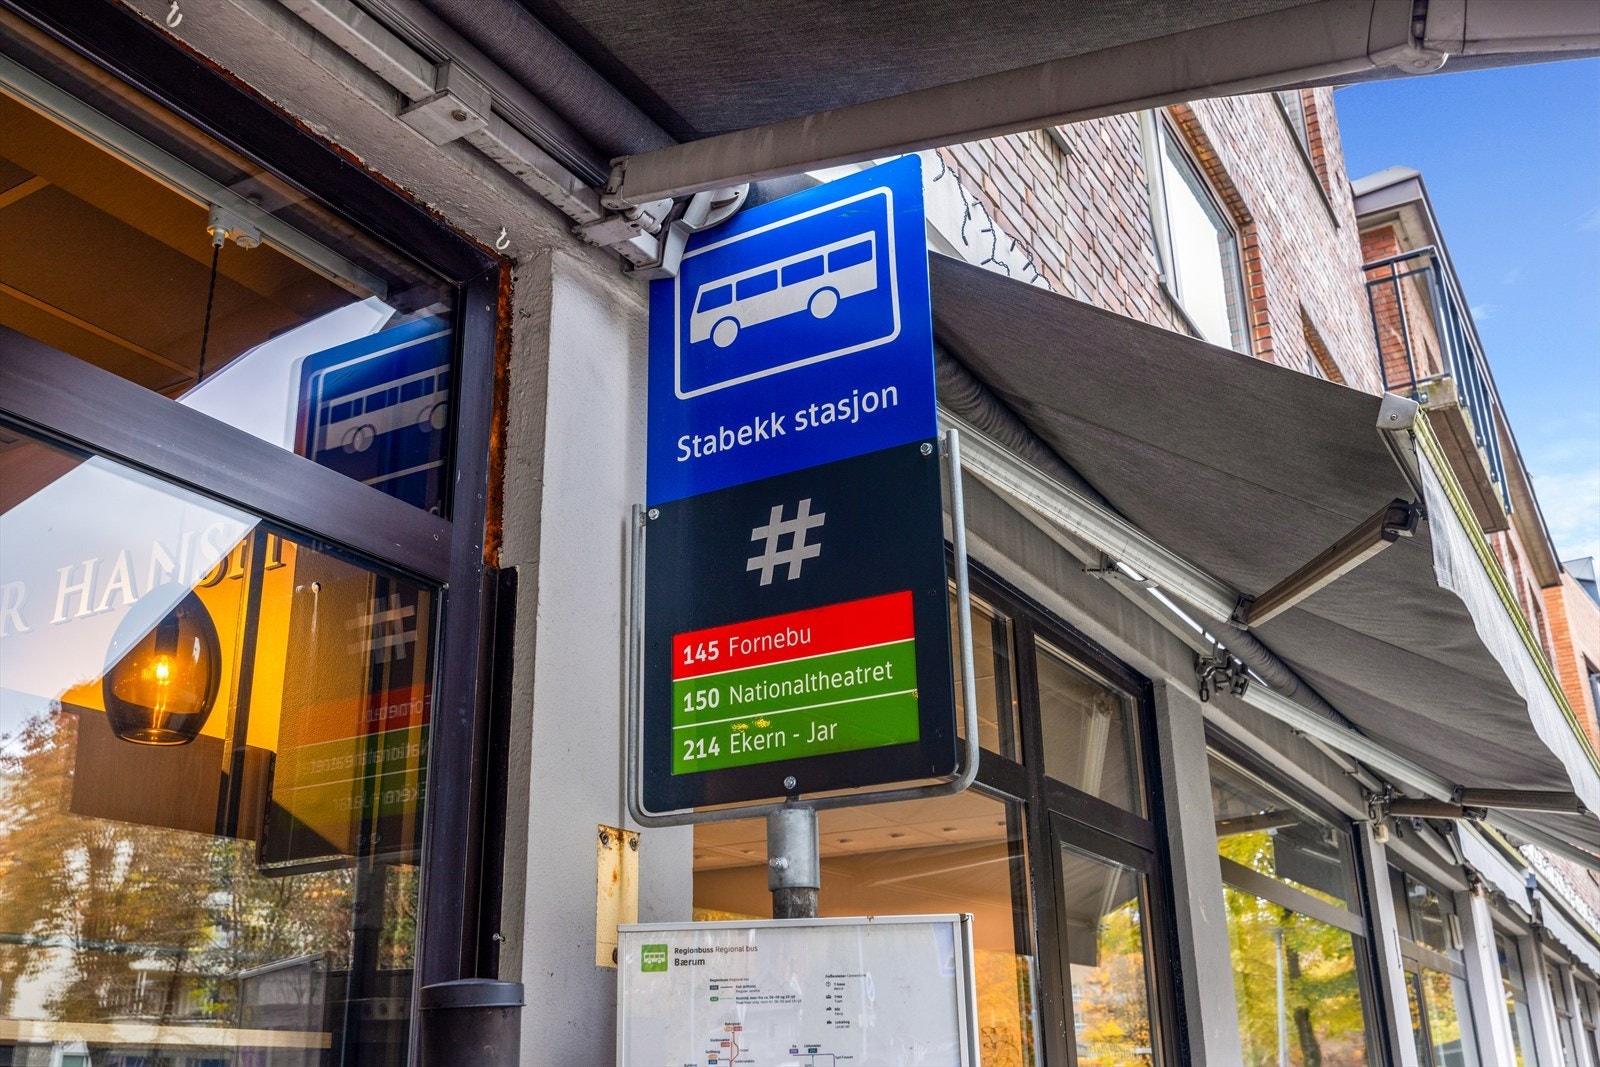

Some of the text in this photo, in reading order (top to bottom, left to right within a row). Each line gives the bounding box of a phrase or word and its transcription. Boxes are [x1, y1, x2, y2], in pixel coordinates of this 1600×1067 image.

[677, 384, 898, 463] Stabekk stasjon
[682, 626, 811, 666] 145 Fornebu
[682, 660, 893, 713] 150 Nationaltheatret
[682, 738, 720, 761] 214
[729, 728, 786, 755] Ekern
[807, 719, 838, 744] Jar
[674, 944, 759, 956] Regionbuss Regional bus
[674, 958, 706, 967] Bærum
